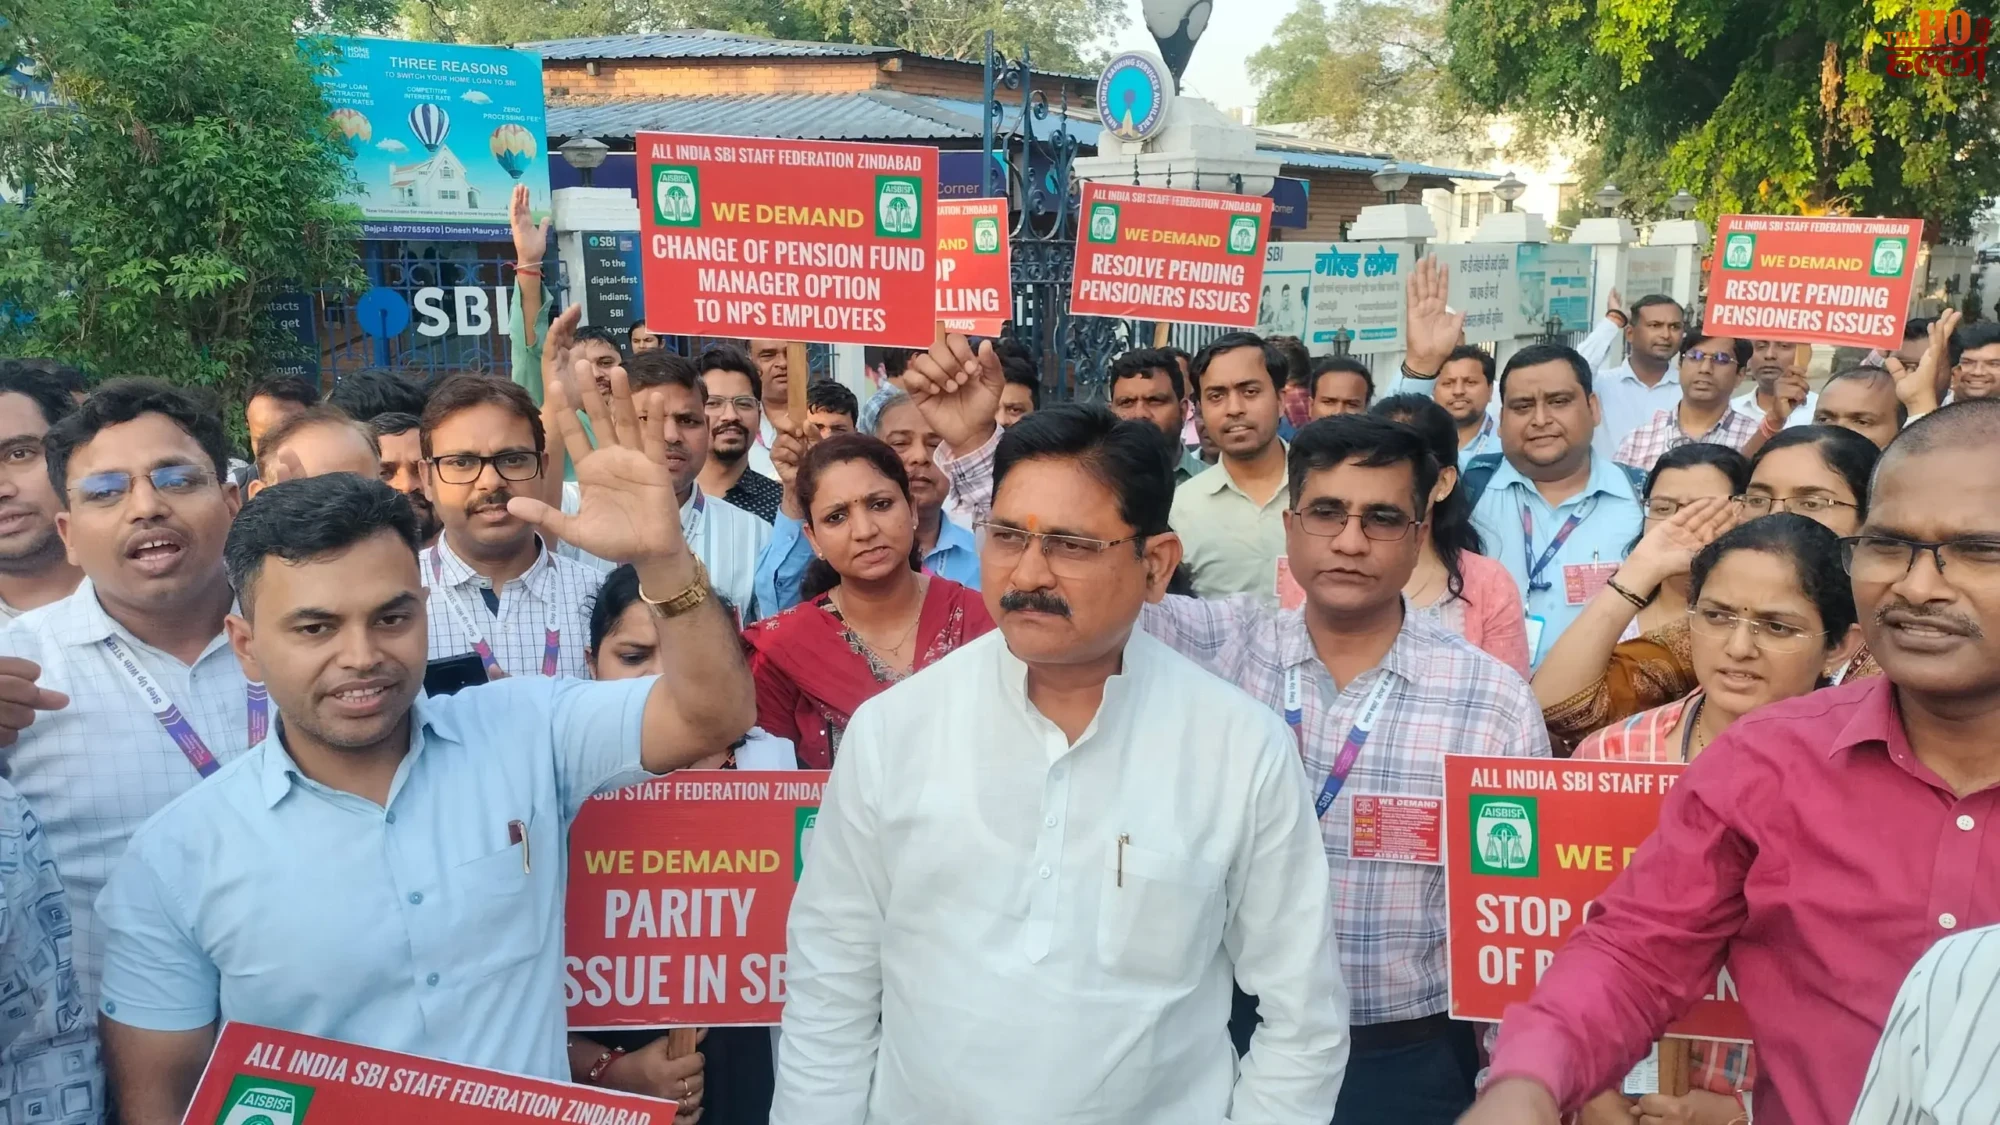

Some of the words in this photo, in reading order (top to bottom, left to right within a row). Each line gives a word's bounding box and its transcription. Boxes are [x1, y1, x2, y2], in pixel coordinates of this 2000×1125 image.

[347, 46, 370, 54] HOME
[389, 56, 437, 71] THREE
[441, 60, 509, 76] REASONS
[1107, 58, 1135, 79] BANKING
[1136, 60, 1160, 91] SERVICES
[385, 71, 395, 79] TO
[396, 72, 425, 80] SWITCH
[427, 74, 448, 82] YOUR
[472, 77, 492, 85] LOAN
[404, 93, 437, 101] INTEREST
[407, 86, 447, 95] COMPETITIVE
[1101, 79, 1110, 107] FOREX
[483, 113, 525, 121] PROCESSING
[1138, 91, 1161, 132] AVAILABLE
[1106, 114, 1118, 129] NRI
[652, 143, 674, 160] ALL
[676, 145, 712, 162] INDIA
[715, 147, 736, 163] SBI
[739, 149, 776, 165] STAFF
[778, 150, 854, 169] FEDERATION
[857, 153, 922, 171] ZINDABAD
[662, 174, 689, 183] AISBISF
[885, 185, 912, 194] AISBISF
[962, 204, 998, 215] ZINDABAD
[1093, 189, 1107, 200] ALL
[1108, 191, 1130, 203] INDIA
[1132, 192, 1145, 204] SBI
[1147, 193, 1171, 205] STAFF
[1172, 195, 1218, 210] FEDERATION
[1221, 199, 1262, 213] ZINDABAD
[711, 202, 750, 223] WE
[756, 204, 864, 228] DEMAND
[364, 224, 388, 234] Bajpai
[392, 225, 440, 234] 8077655670
[445, 227, 471, 235] Dinesh
[472, 228, 500, 237] Maurya
[1729, 220, 1744, 230] ALL
[1745, 220, 1768, 231] INDIA
[1769, 221, 1783, 231] SBI
[1784, 221, 1810, 232] STAFF
[1810, 222, 1862, 233] FEDERATION
[1863, 223, 1910, 235] ZINDABAD
[599, 236, 616, 247] SBI
[938, 238, 969, 250] AND
[1124, 227, 1150, 242] WE
[1152, 230, 1221, 248] DEMAND
[652, 234, 738, 263] CHANGE
[743, 238, 770, 264] OF
[775, 240, 865, 269] PENSION
[870, 245, 925, 272] FUND
[1267, 246, 1283, 262] SBI
[1315, 244, 1361, 278] गोल्ड
[1364, 244, 1399, 277] लोन
[1760, 254, 1787, 268] WE
[1789, 255, 1863, 271] DEMAND
[600, 259, 611, 267] To
[612, 259, 626, 267] the
[1092, 253, 1166, 279] RESOLVE
[1168, 260, 1245, 286] PENDING
[591, 275, 638, 286] digital-first
[698, 268, 800, 297] MANAGER
[805, 273, 881, 301] OPTION
[599, 293, 632, 302] indians,
[936, 288, 999, 312] LLING
[1079, 280, 1185, 308] PENSIONERS
[1188, 288, 1251, 313] ISSUES
[1725, 279, 1802, 304] RESOLVE
[1805, 284, 1889, 309] PENDING
[413, 286, 510, 337] SBI
[610, 309, 624, 317] SBI
[694, 299, 720, 323] TO
[726, 302, 767, 326] NPS
[772, 303, 887, 332] EMPLOYEES
[1711, 304, 1823, 331] PENSIONERS
[1826, 311, 1896, 336] ISSUES
[280, 318, 300, 330] get
[276, 365, 307, 375] ount.
[123, 659, 140, 677] With
[137, 674, 149, 688] Up
[146, 686, 162, 705] Step
[1471, 768, 1502, 788] ALL
[1506, 770, 1557, 790] INDIA
[1562, 771, 1593, 792] SBI
[1598, 773, 1654, 794] STAFF
[624, 782, 670, 801] STAFF
[675, 782, 769, 801] FEDERATION
[774, 782, 828, 801] ZINDA
[1319, 792, 1334, 808] SBI
[1379, 798, 1394, 806] WE
[1396, 799, 1438, 809] DEMAND
[1484, 807, 1523, 819] AISBISF
[585, 850, 634, 874] WE
[643, 849, 780, 874] DEMAND
[1555, 844, 1613, 871] WE
[604, 888, 756, 938] PARITY
[1476, 893, 1572, 937] STOP
[1478, 945, 1524, 986] OF
[564, 955, 671, 1007] SSUE
[683, 954, 727, 1004] IN
[740, 953, 788, 1004] SB
[244, 1042, 283, 1072] ALL
[286, 1049, 346, 1083] INDIA
[350, 1062, 390, 1089] SBI
[394, 1068, 452, 1099] STAFF
[450, 1079, 562, 1116] FEDERATION
[244, 1093, 292, 1111] AISBISF
